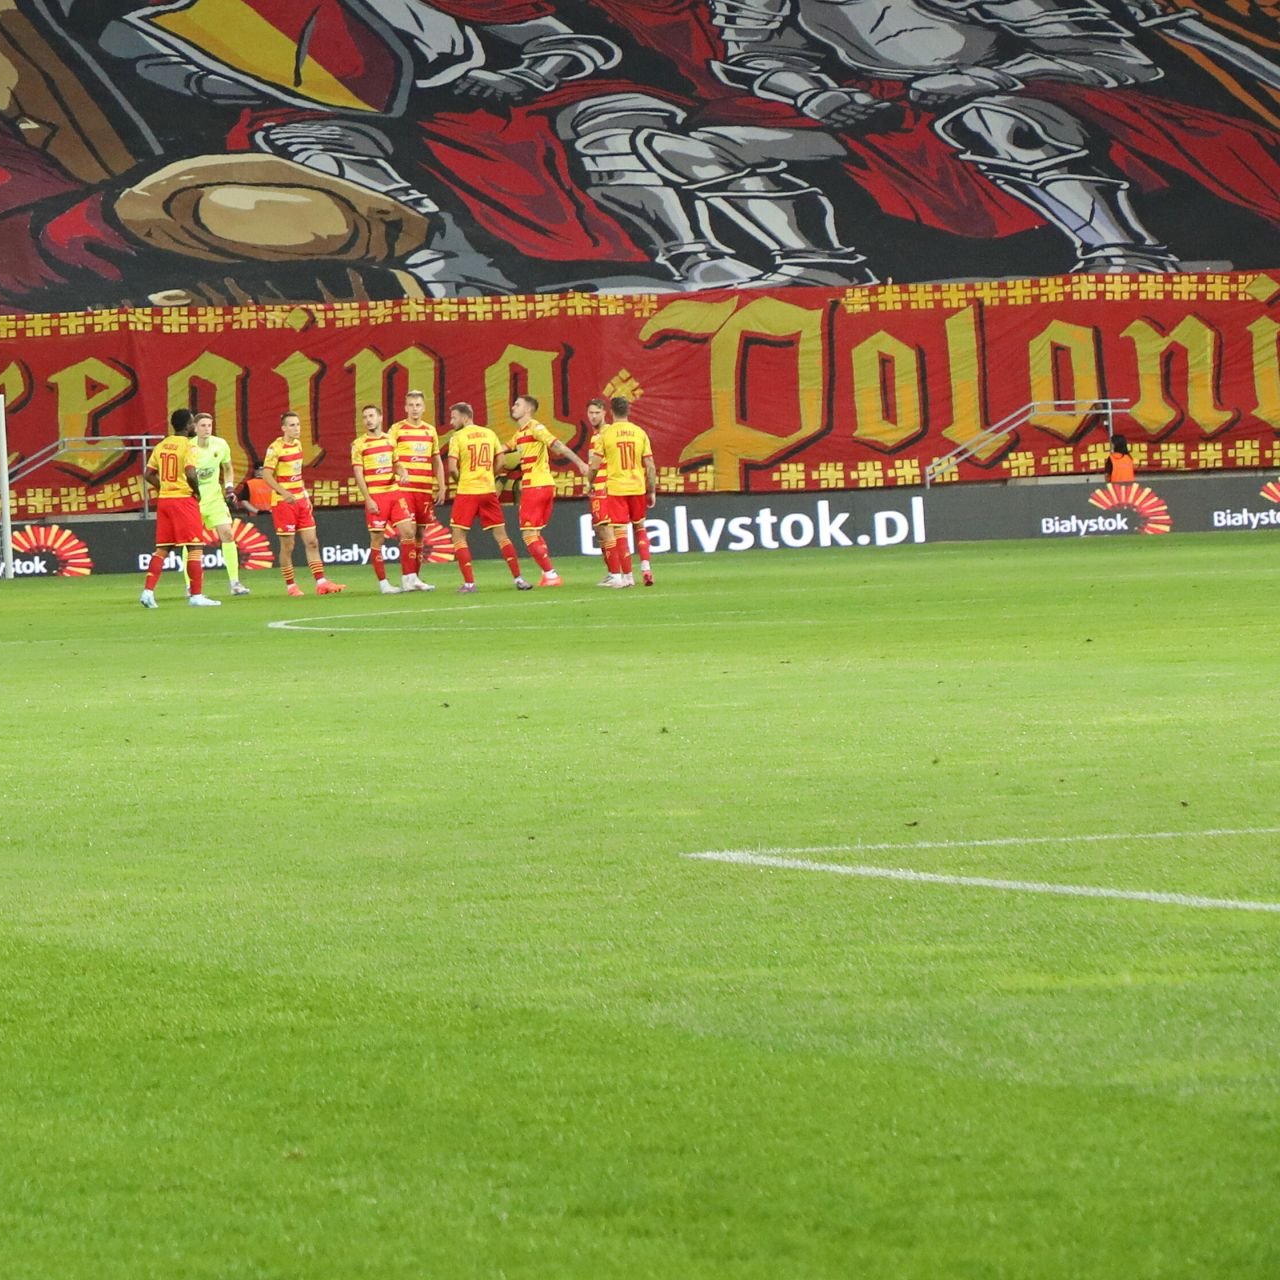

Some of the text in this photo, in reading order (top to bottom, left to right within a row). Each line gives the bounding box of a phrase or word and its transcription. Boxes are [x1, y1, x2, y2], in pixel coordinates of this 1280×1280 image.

[159, 452, 178, 482] 10
[467, 443, 491, 472] 14
[616, 441, 635, 470] 11
[1041, 513, 1128, 536] Białystok
[138, 549, 227, 572] Błyok
[322, 543, 401, 565] Białyto
